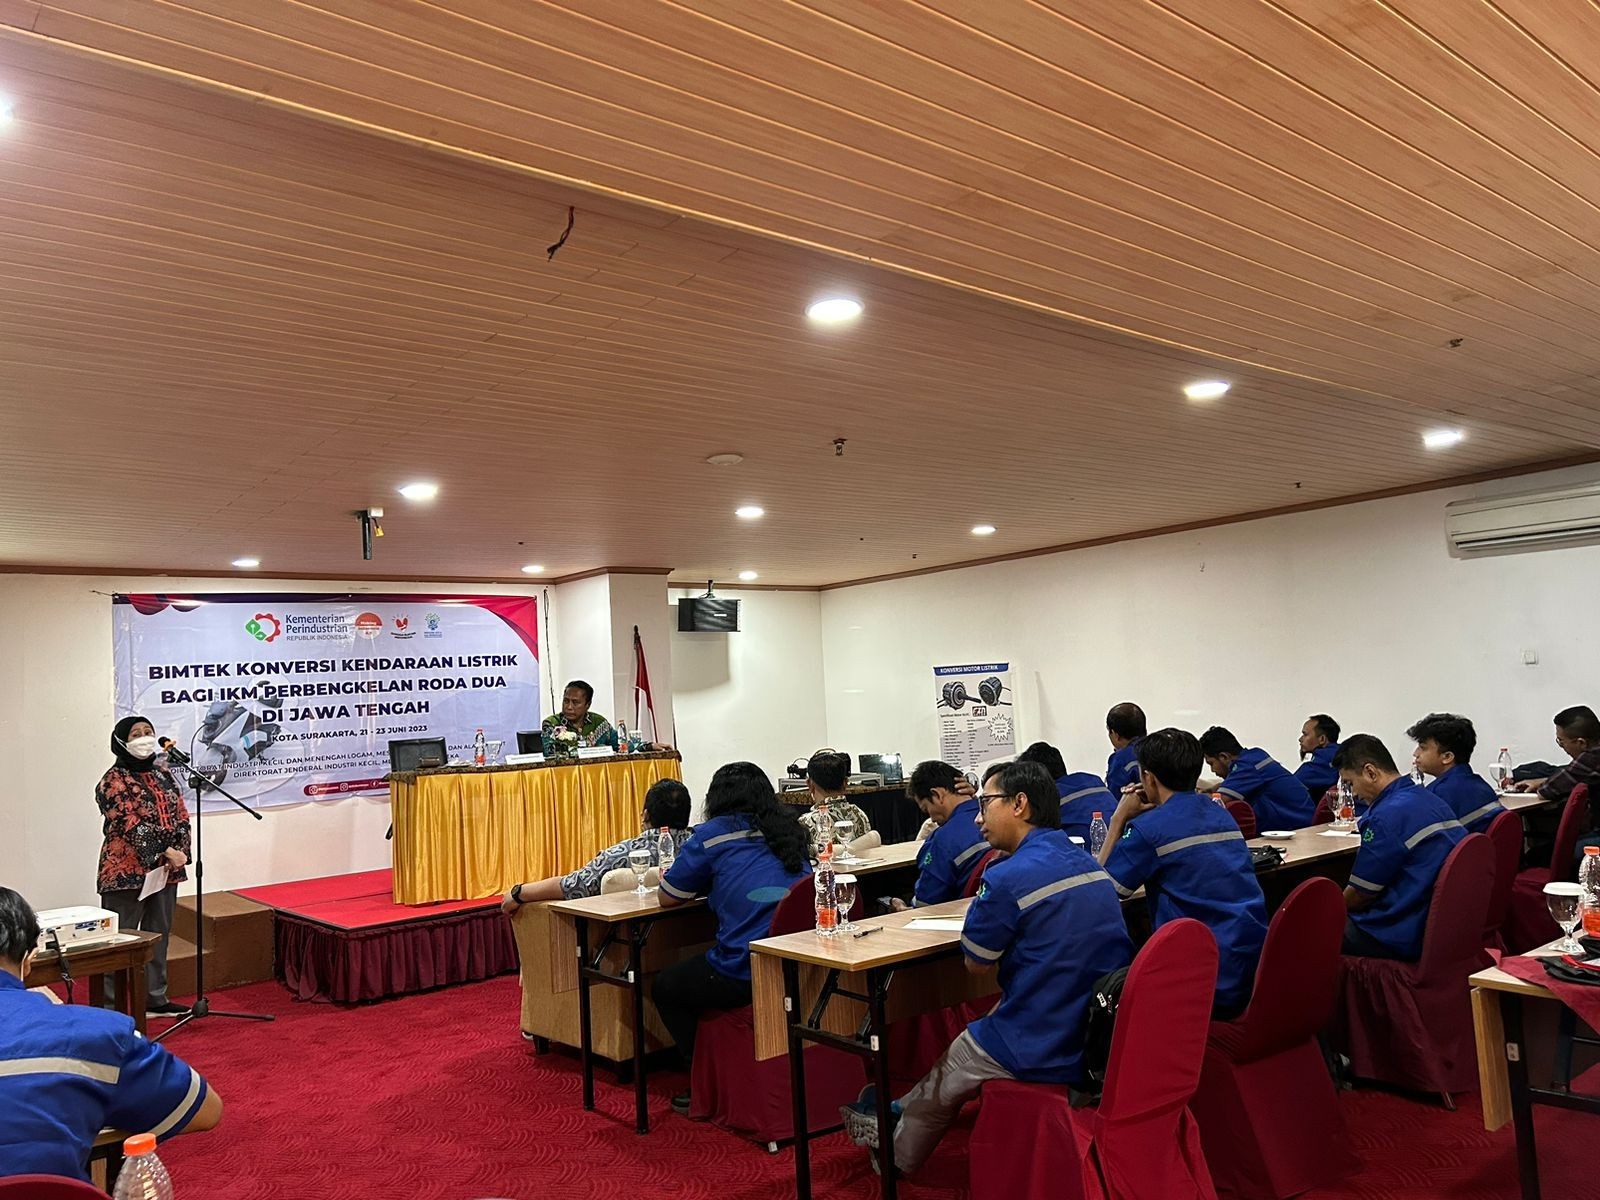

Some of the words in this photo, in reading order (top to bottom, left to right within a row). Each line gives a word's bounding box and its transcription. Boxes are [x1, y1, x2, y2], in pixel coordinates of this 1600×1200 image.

[285, 613, 345, 624] Kementerian
[286, 623, 348, 634] Perindustrian
[149, 663, 231, 680] BIMTEK
[236, 660, 337, 676] KONVERSI
[341, 657, 453, 672] KENDARAAN
[458, 654, 518, 668] LISTRIK
[161, 688, 214, 704] BAGI
[220, 687, 258, 701] IKM
[263, 680, 413, 698] PERBENGKELAN
[418, 677, 467, 691] RODA
[471, 676, 507, 689] DUA
[262, 709, 284, 723] DI
[288, 705, 350, 721] JAWA
[355, 701, 430, 717] TENGAH
[272, 734, 299, 742] KOTA
[300, 730, 358, 740] SURAKARTA,
[388, 726, 407, 734] JUNI
[262, 758, 285, 766] KECIL
[304, 753, 347, 762] MENENGAH
[233, 768, 283, 778] DIREKTORAT
[284, 764, 322, 774] JENDERAL
[324, 761, 357, 770] INDUSTRI
